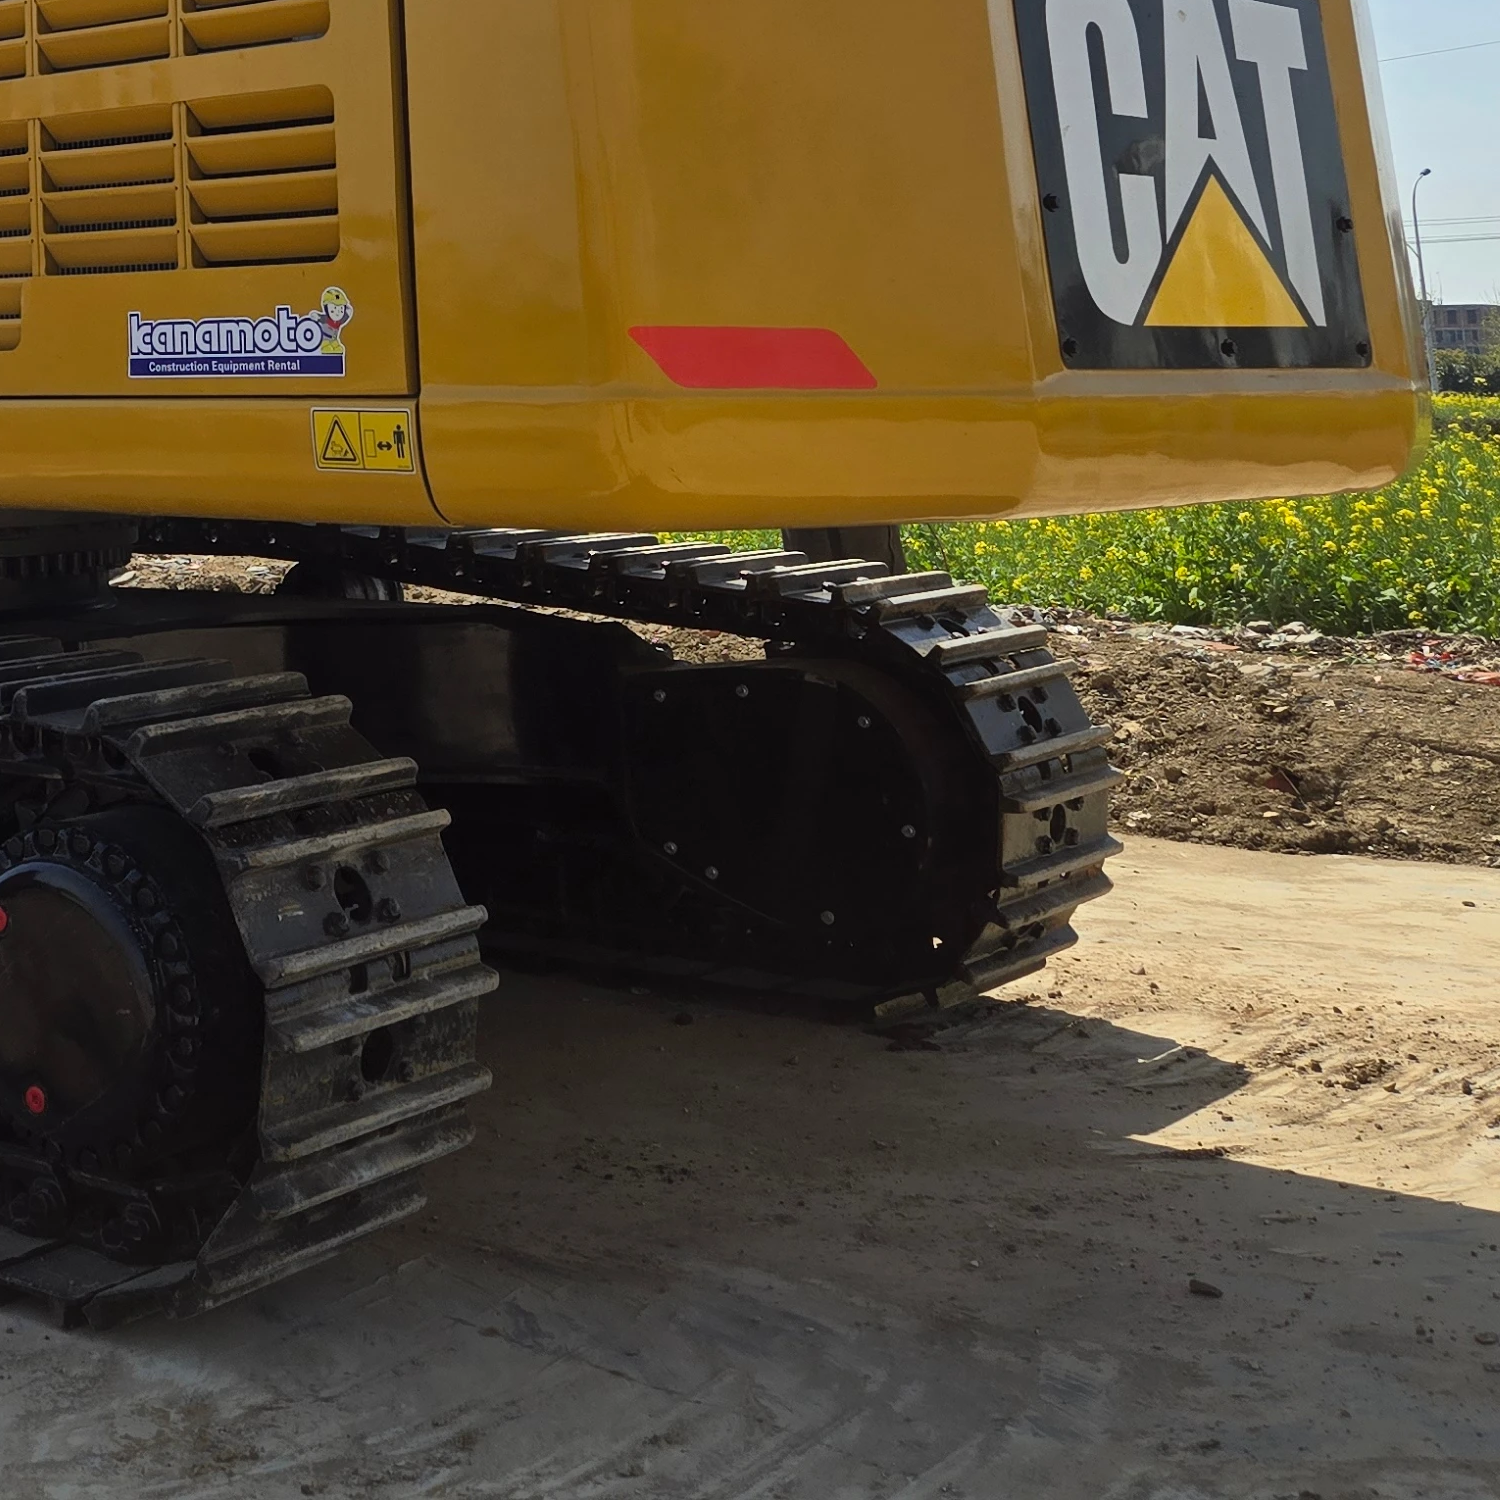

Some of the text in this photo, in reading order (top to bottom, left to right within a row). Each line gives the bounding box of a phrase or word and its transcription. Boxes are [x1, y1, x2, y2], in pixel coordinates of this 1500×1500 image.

[129, 307, 324, 356] kanamoto
[148, 359, 301, 374] Construction Equipment Rental
